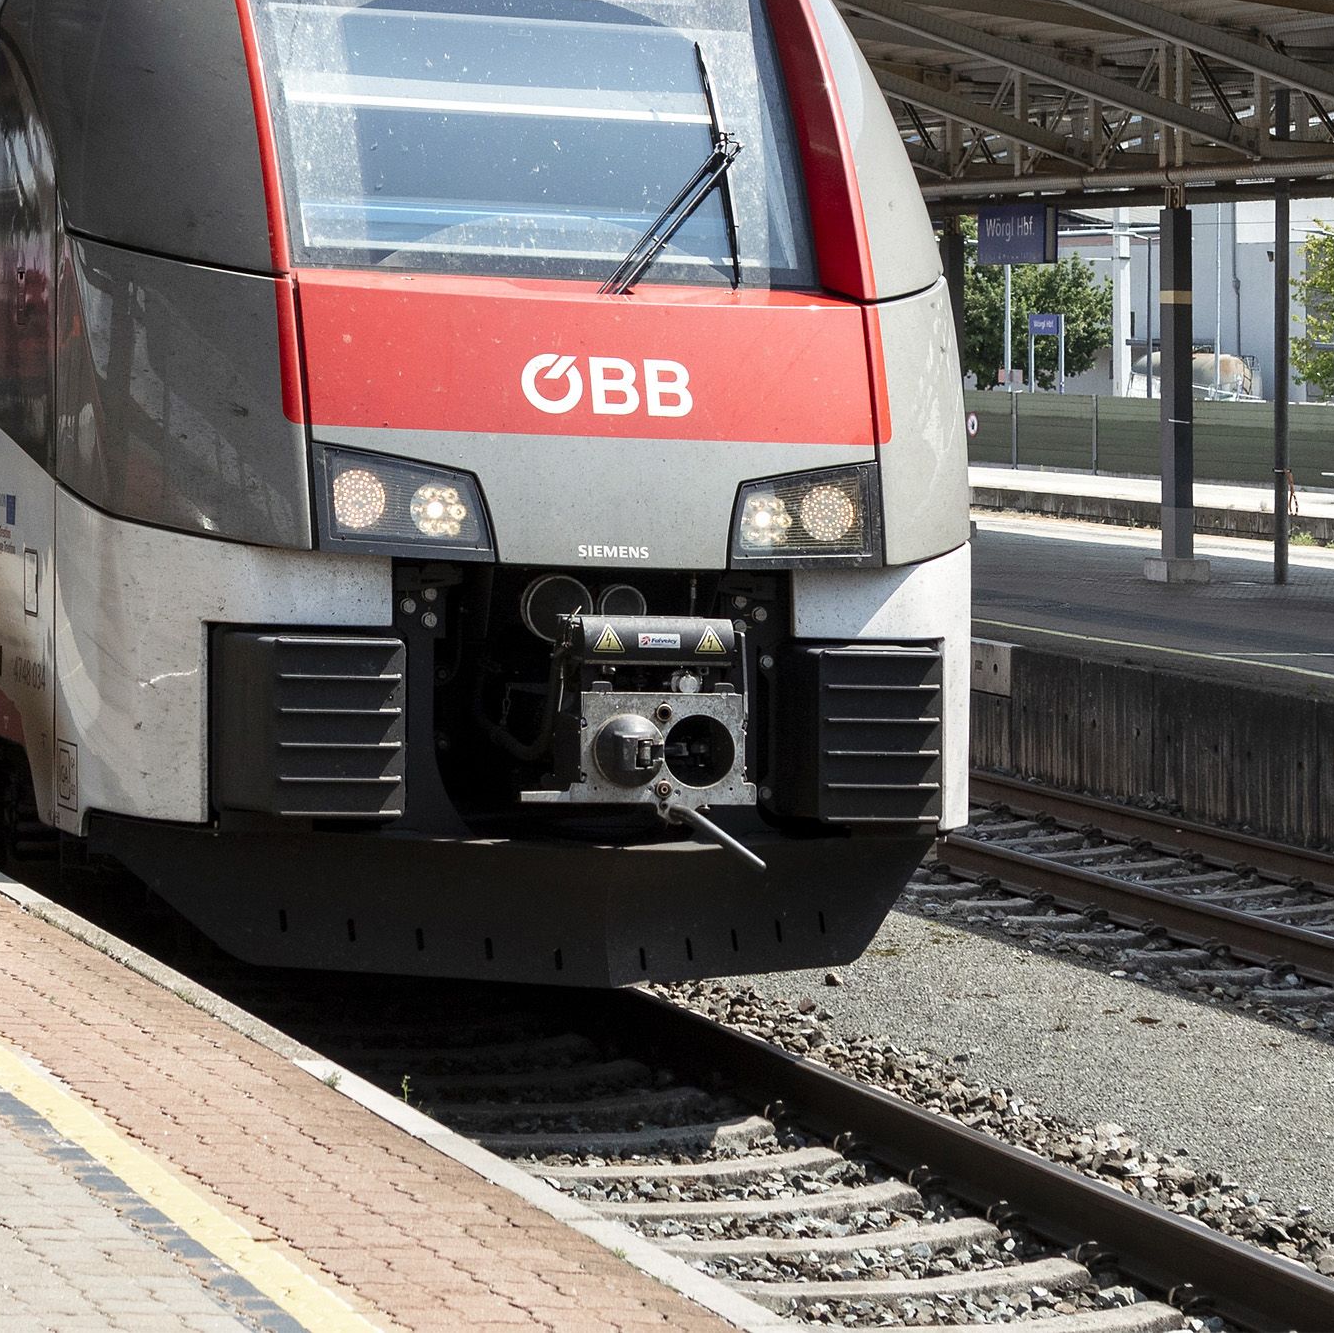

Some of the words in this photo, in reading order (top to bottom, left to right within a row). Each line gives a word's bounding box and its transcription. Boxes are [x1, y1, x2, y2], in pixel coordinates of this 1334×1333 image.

[986, 218, 1014, 242] Wörgl
[1017, 216, 1035, 236] Hbf.
[521, 353, 694, 418] ÖBB
[578, 544, 650, 559] SIEMENS
